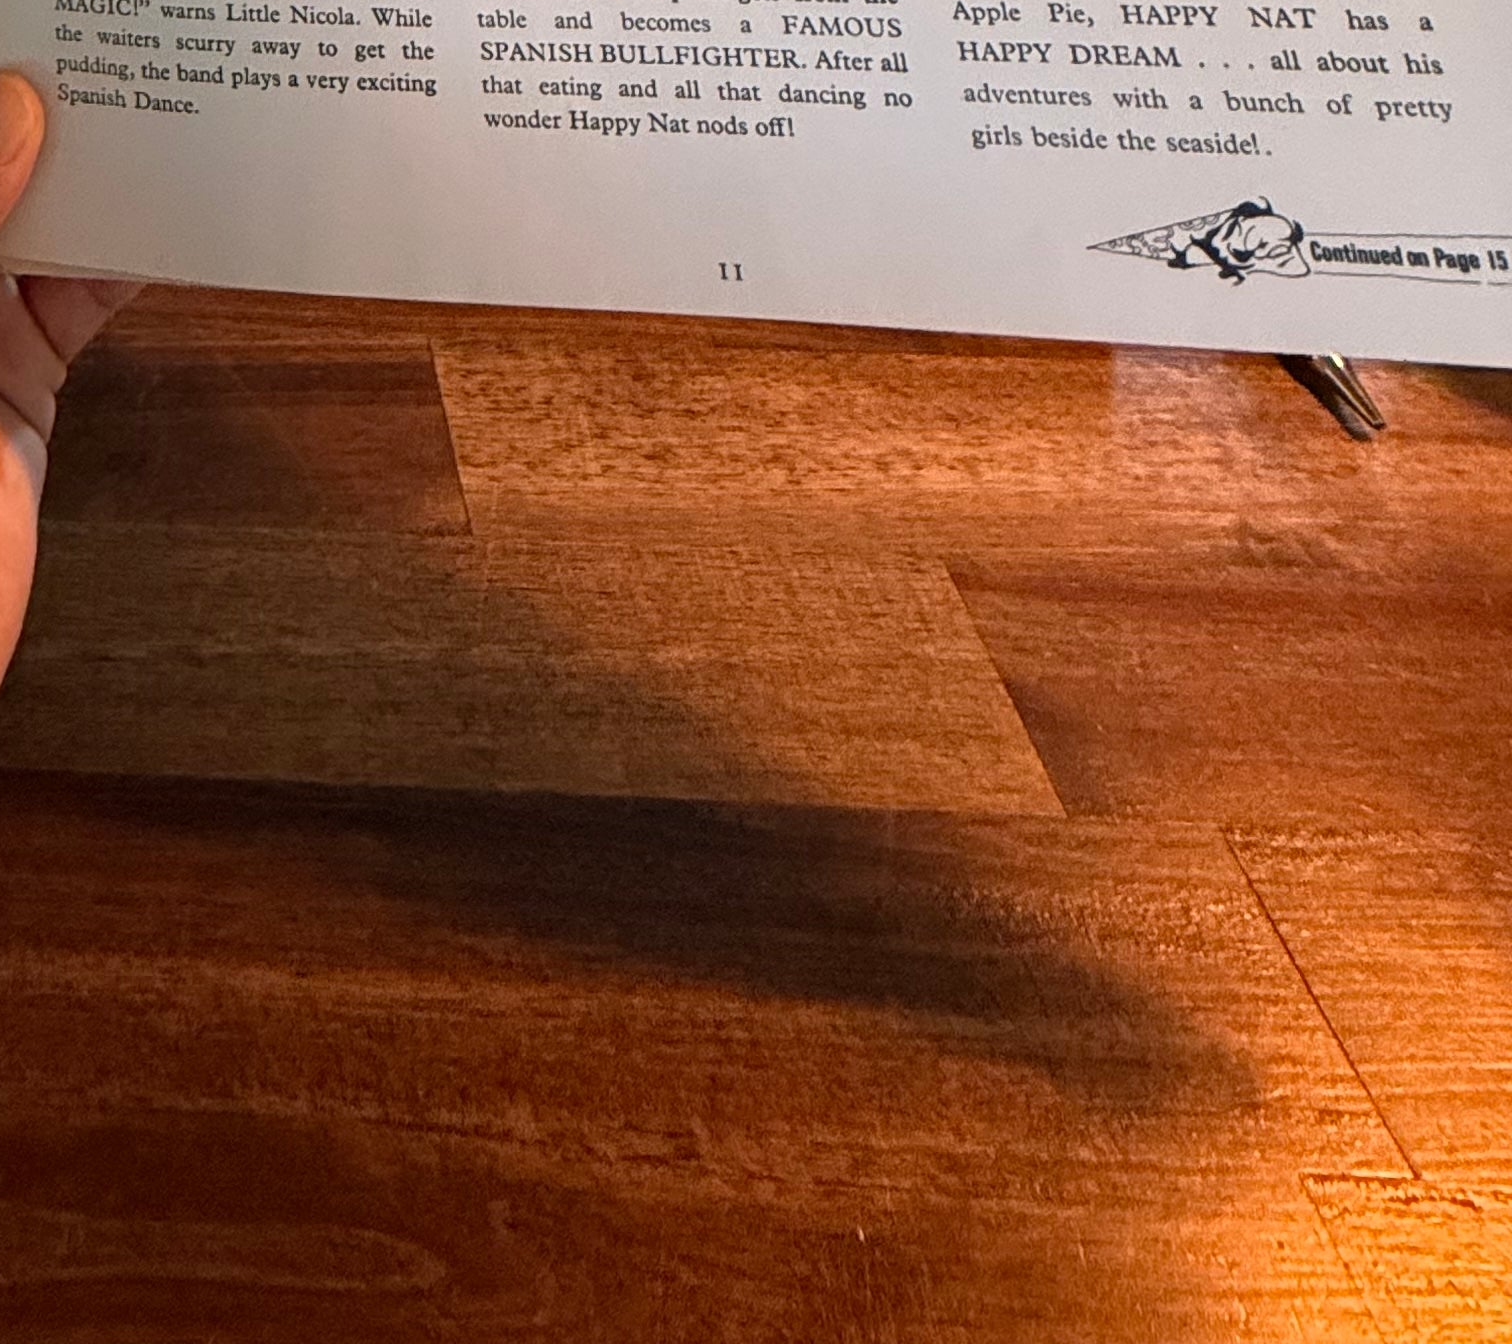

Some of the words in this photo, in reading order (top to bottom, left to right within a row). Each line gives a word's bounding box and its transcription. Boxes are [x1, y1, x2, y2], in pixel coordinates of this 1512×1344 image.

[477, 8, 527, 29] table
[555, 10, 593, 30] and
[620, 10, 711, 33] becomes
[741, 19, 752, 34] a
[782, 14, 902, 39] FAMOUS
[953, 0, 1021, 27] Apple
[1047, 2, 1094, 28] Pie,
[1120, 4, 1218, 28] HAPPY
[1247, 6, 1316, 30] NAT
[1345, 8, 1389, 32] has
[1419, 16, 1433, 32] a
[56, 23, 82, 42] the
[97, 28, 160, 50] waiters
[176, 37, 235, 57] scurry
[252, 40, 301, 61] away
[318, 41, 337, 58] to
[355, 43, 385, 63] get
[402, 39, 434, 61] the
[57, 55, 134, 82] pudding,
[141, 60, 169, 81] the
[176, 62, 224, 84] band
[232, 66, 280, 91] plays
[289, 74, 299, 88] a
[307, 74, 349, 95] very
[357, 72, 437, 97] exciting
[1309, 240, 1403, 267] Continued
[1406, 250, 1430, 268] on
[1433, 247, 1482, 273] Page
[1487, 250, 1509, 271] 15
